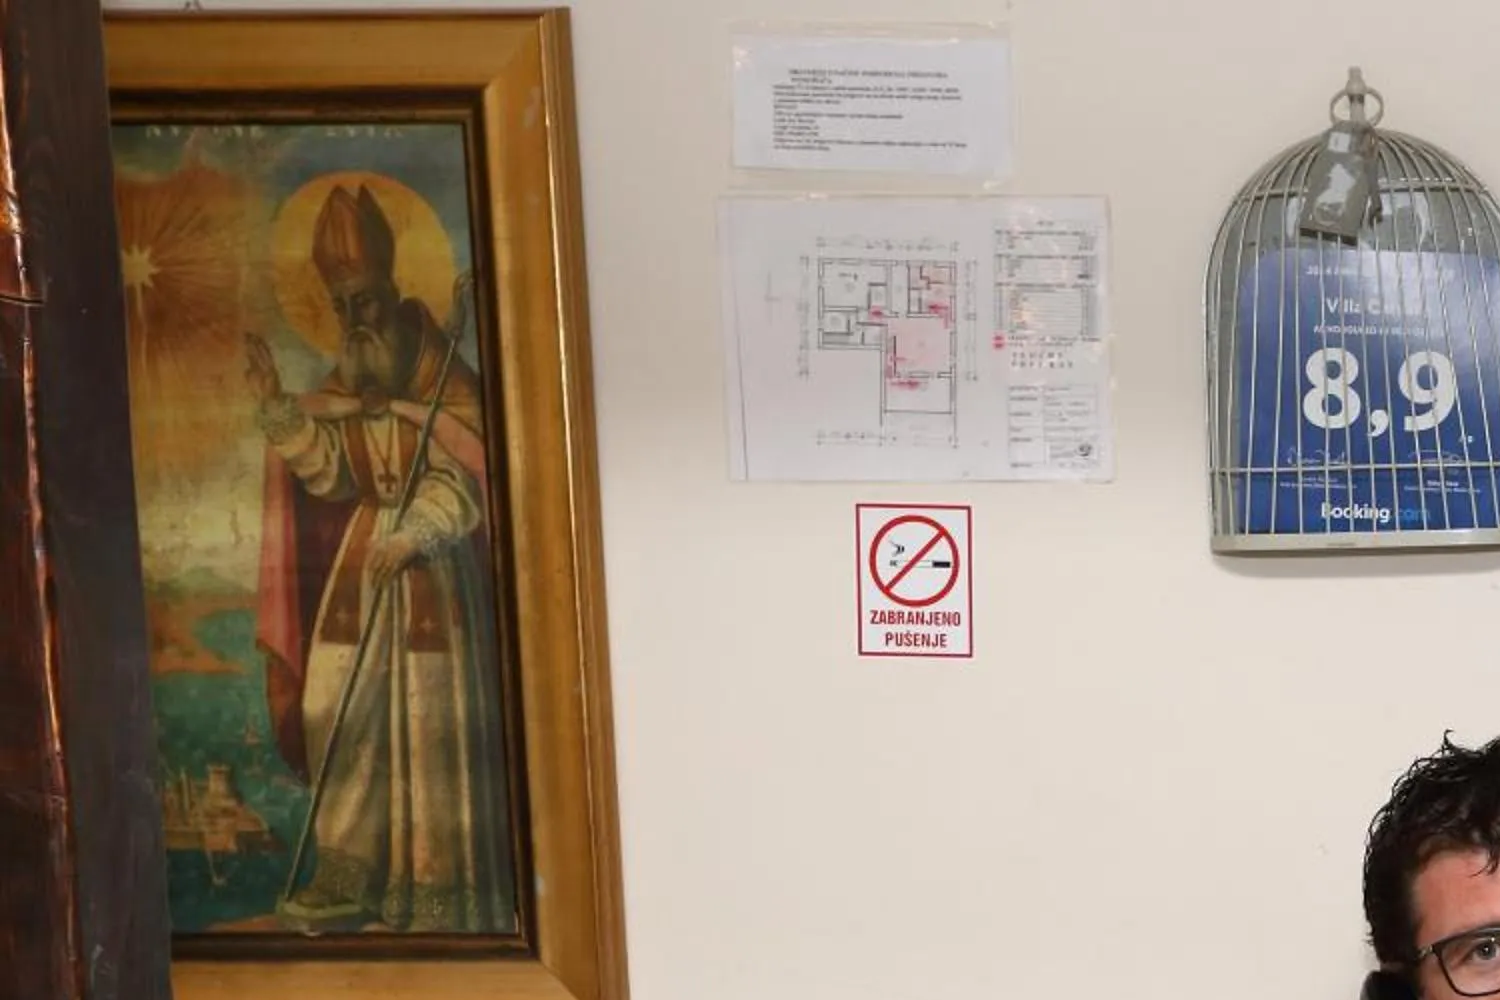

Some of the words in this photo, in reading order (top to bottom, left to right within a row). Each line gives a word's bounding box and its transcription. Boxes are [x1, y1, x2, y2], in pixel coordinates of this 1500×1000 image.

[1302, 347, 1457, 437] 8,9
[869, 609, 961, 627] ZABRANJENO
[884, 629, 948, 648] PUŠENJE
